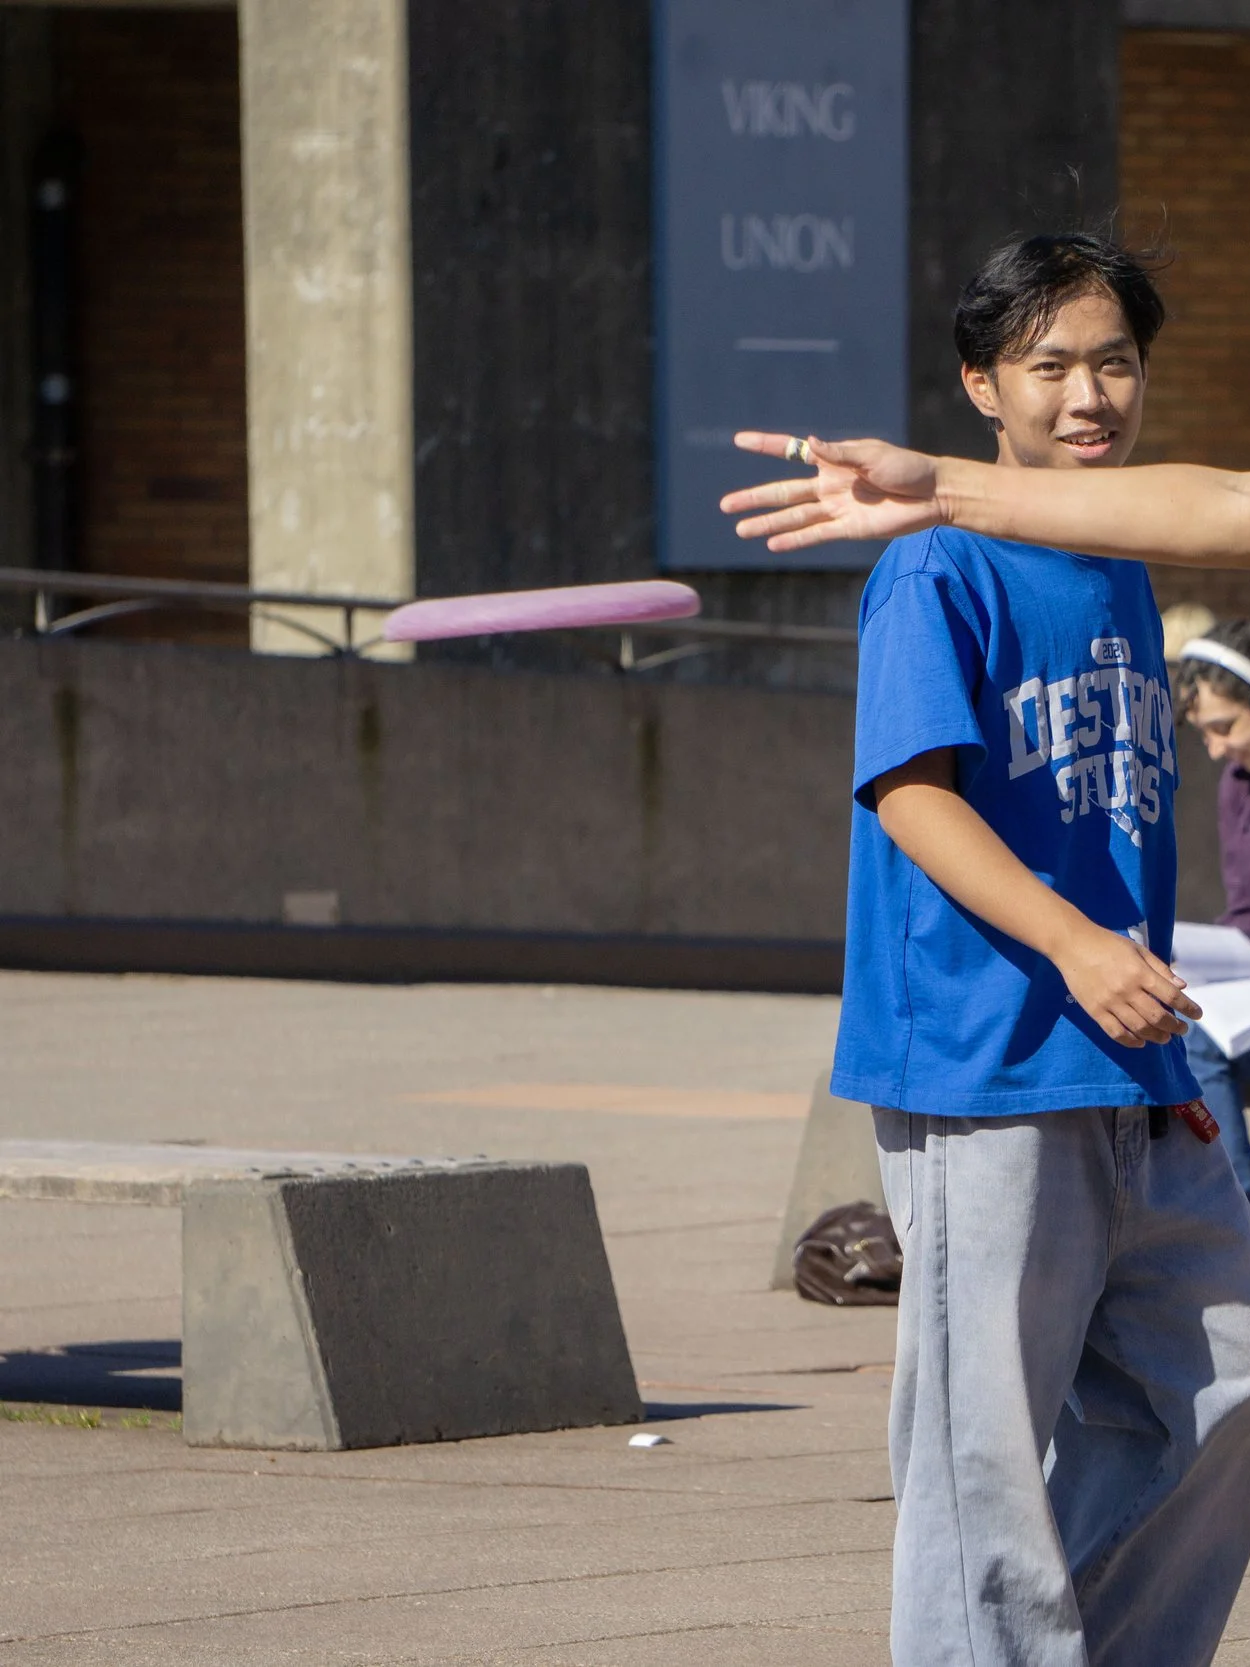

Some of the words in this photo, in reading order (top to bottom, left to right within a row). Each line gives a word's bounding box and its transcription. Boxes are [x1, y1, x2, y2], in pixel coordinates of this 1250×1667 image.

[721, 77, 857, 142] VIKING
[720, 213, 856, 274] UNION
[1003, 667, 1174, 781] DESTROY
